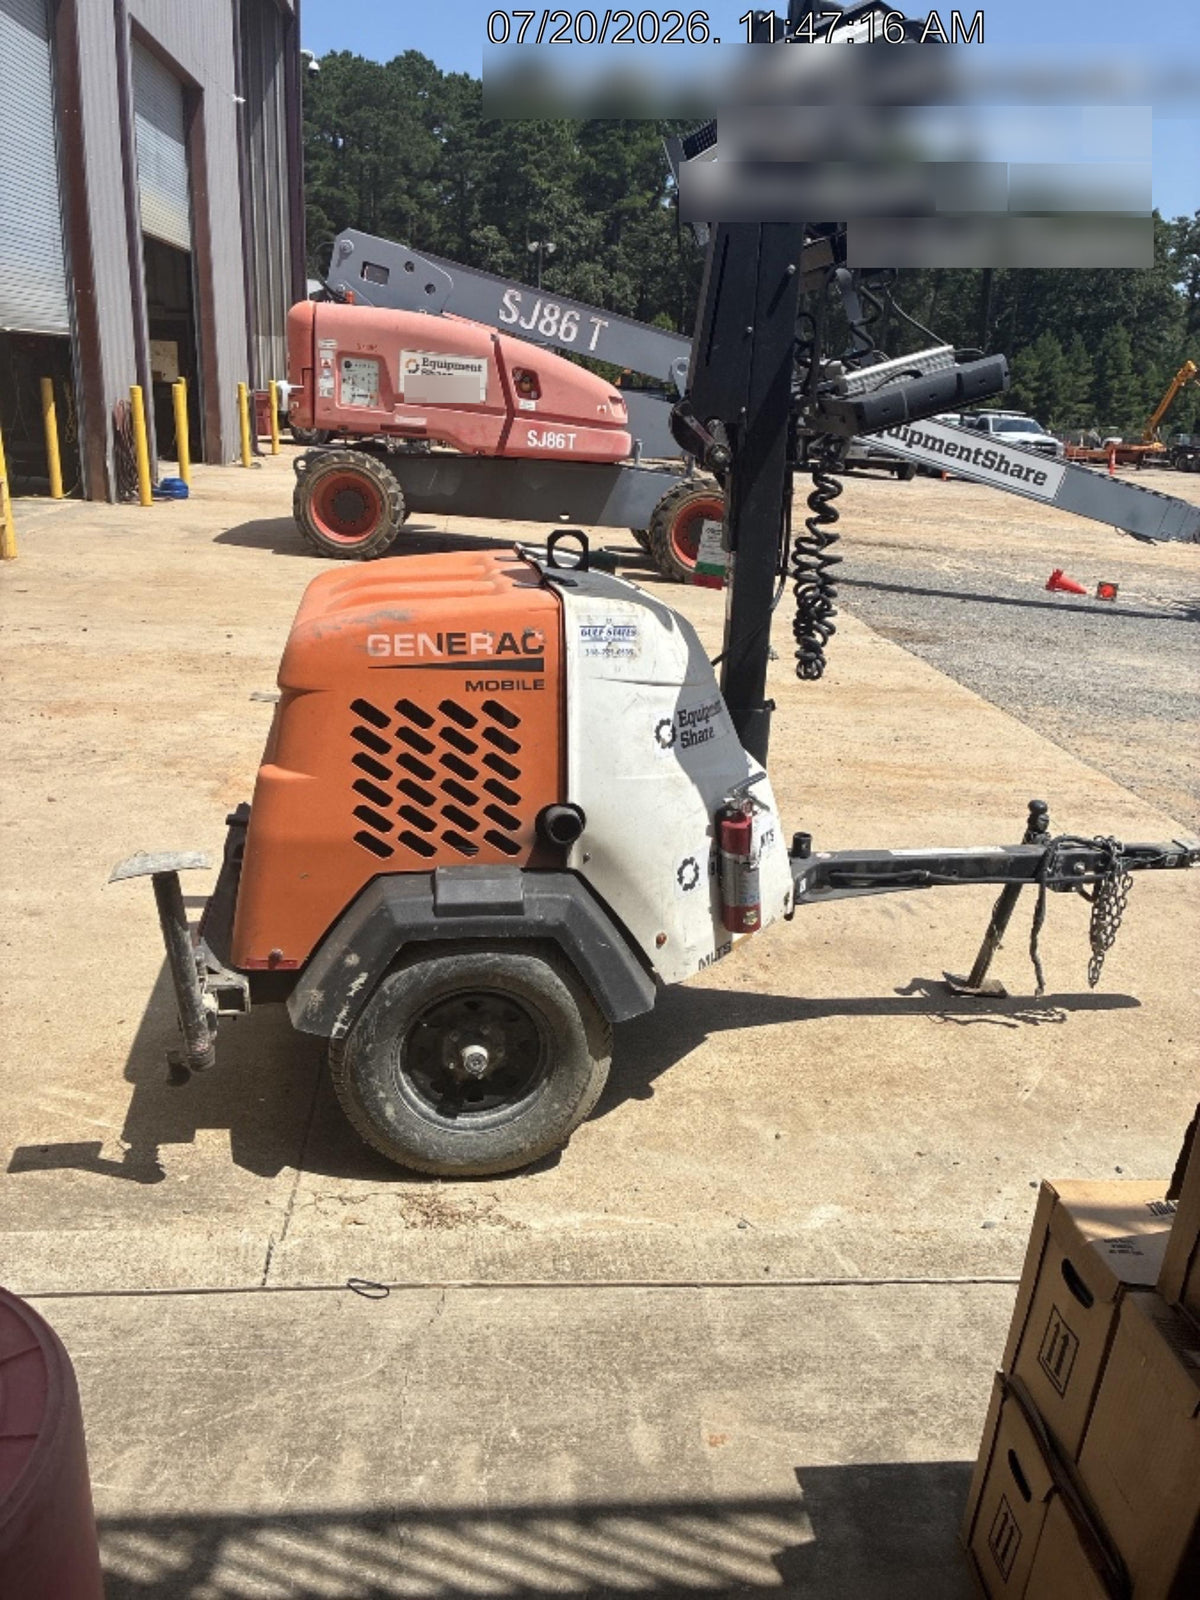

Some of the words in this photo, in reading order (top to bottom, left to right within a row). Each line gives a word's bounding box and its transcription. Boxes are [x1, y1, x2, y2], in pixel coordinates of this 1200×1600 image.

[499, 289, 580, 342] SJ86
[589, 316, 609, 351] T
[421, 357, 483, 372] Equipment
[367, 632, 544, 657] GENERAC
[465, 679, 545, 692] MOBILE
[680, 726, 715, 749] Share
